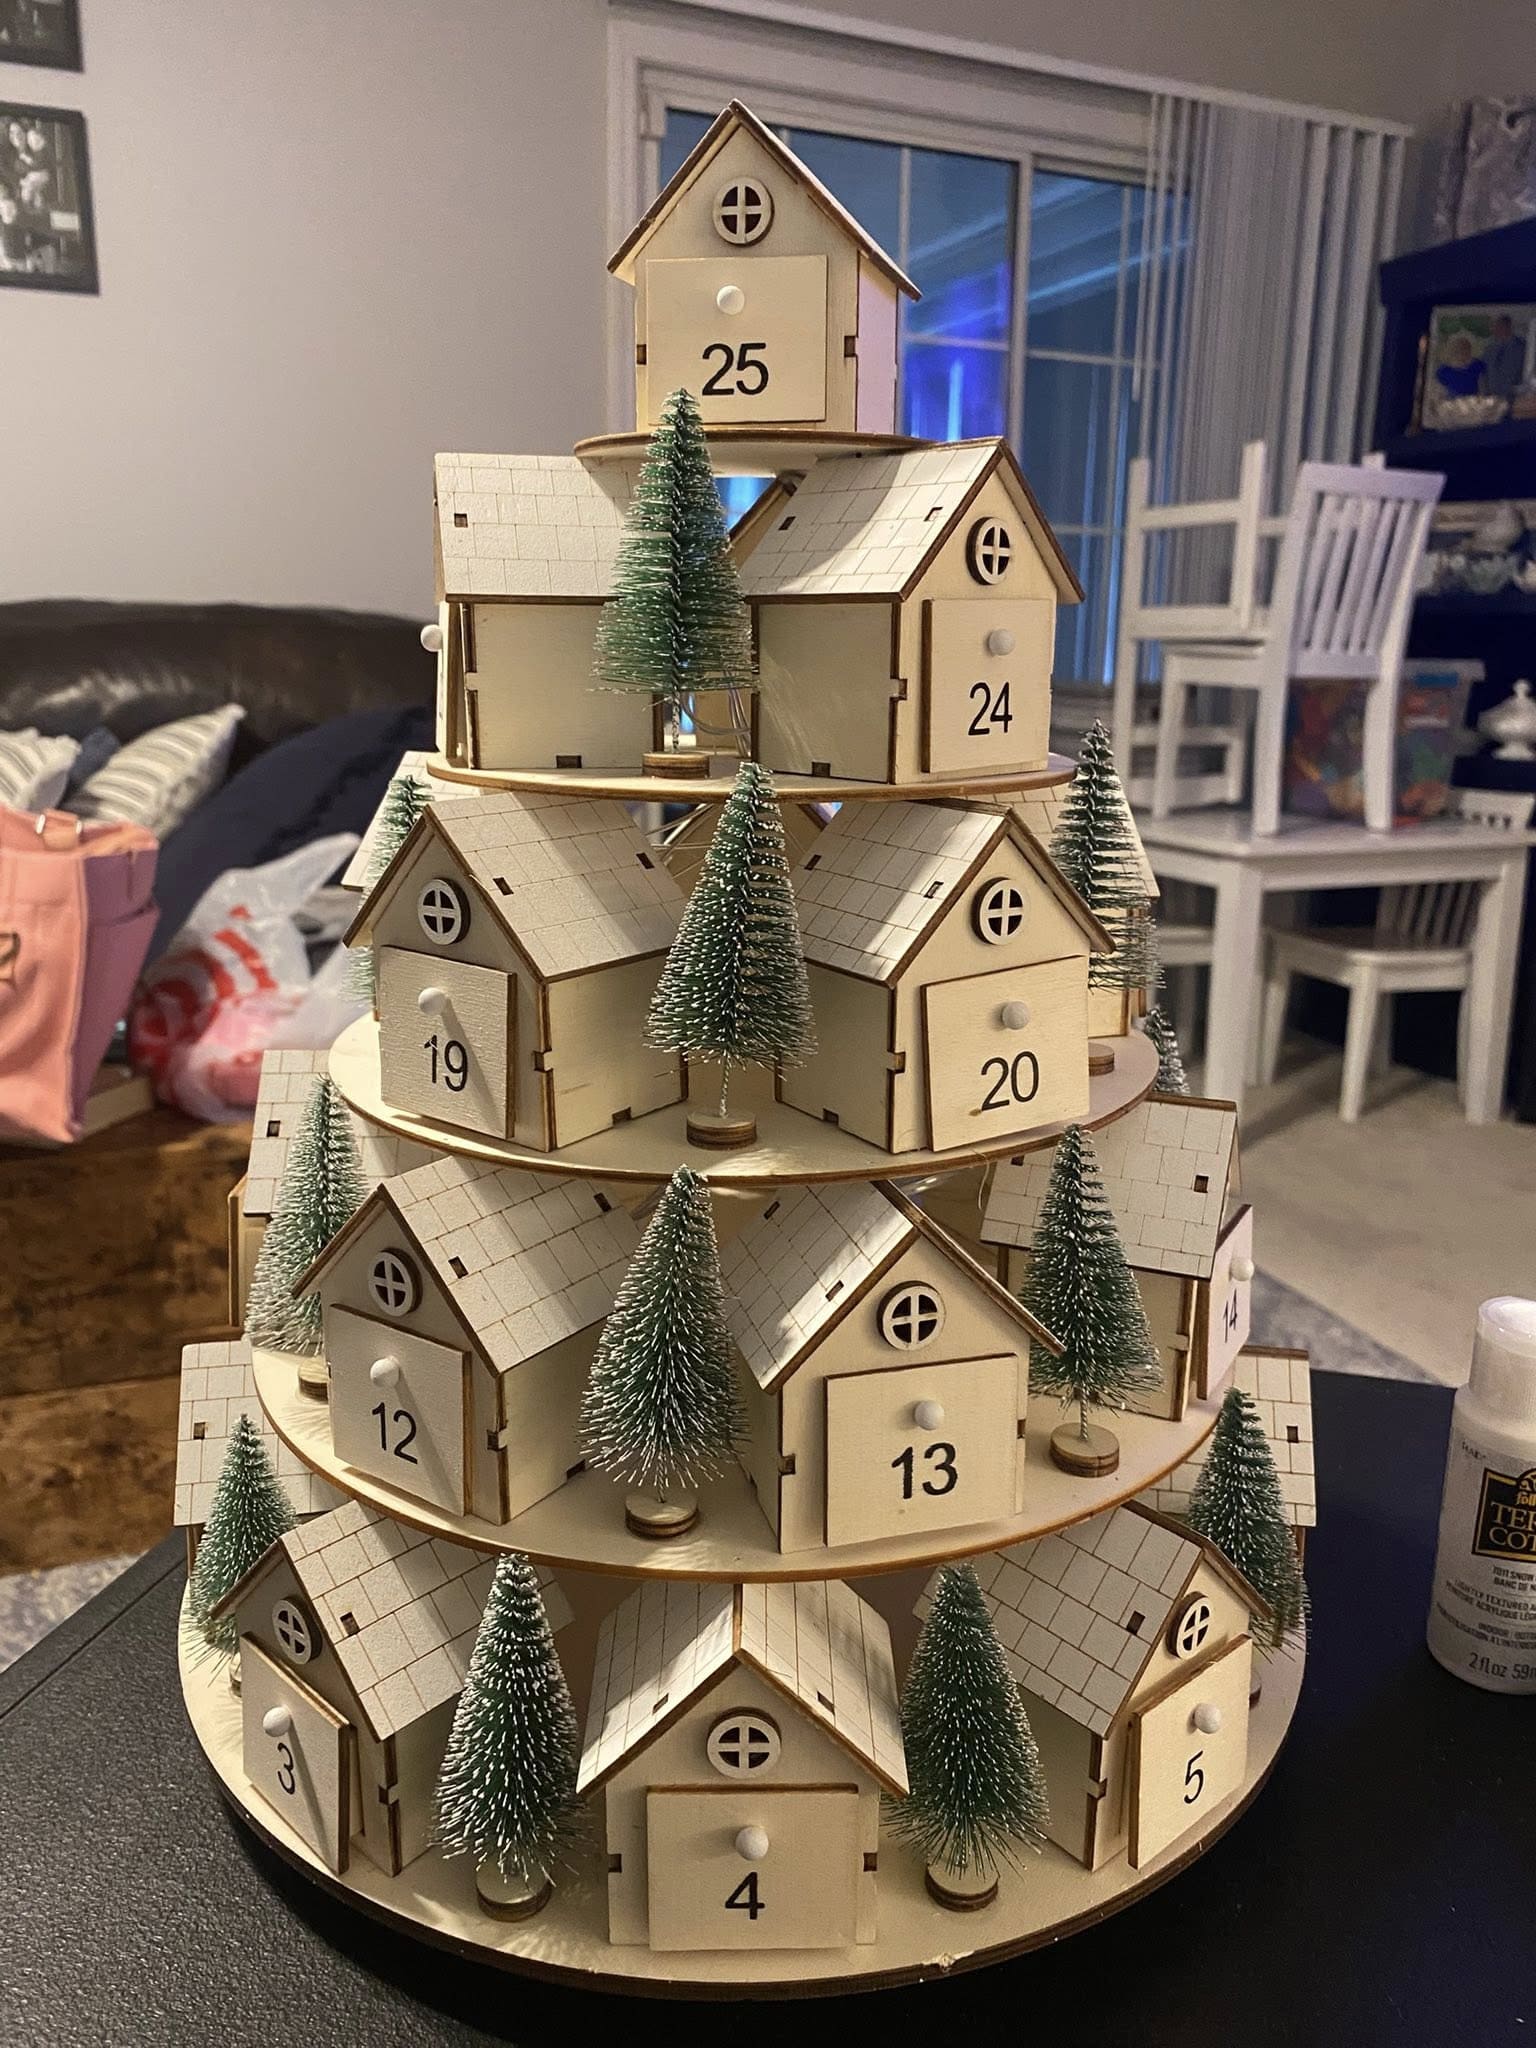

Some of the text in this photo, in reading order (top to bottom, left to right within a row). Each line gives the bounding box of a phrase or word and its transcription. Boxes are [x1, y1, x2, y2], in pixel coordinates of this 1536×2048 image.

[701, 343, 769, 396] 25
[967, 681, 1013, 736] 24
[424, 1034, 469, 1092] 19
[981, 1051, 1039, 1111] 20
[1222, 1288, 1238, 1343] 14
[371, 1402, 418, 1465] 12
[891, 1442, 958, 1500] 13
[1469, 1652, 1479, 1670] 2
[277, 1742, 296, 1795] 3
[1183, 1750, 1204, 1805] 5
[724, 1871, 766, 1921] 4
